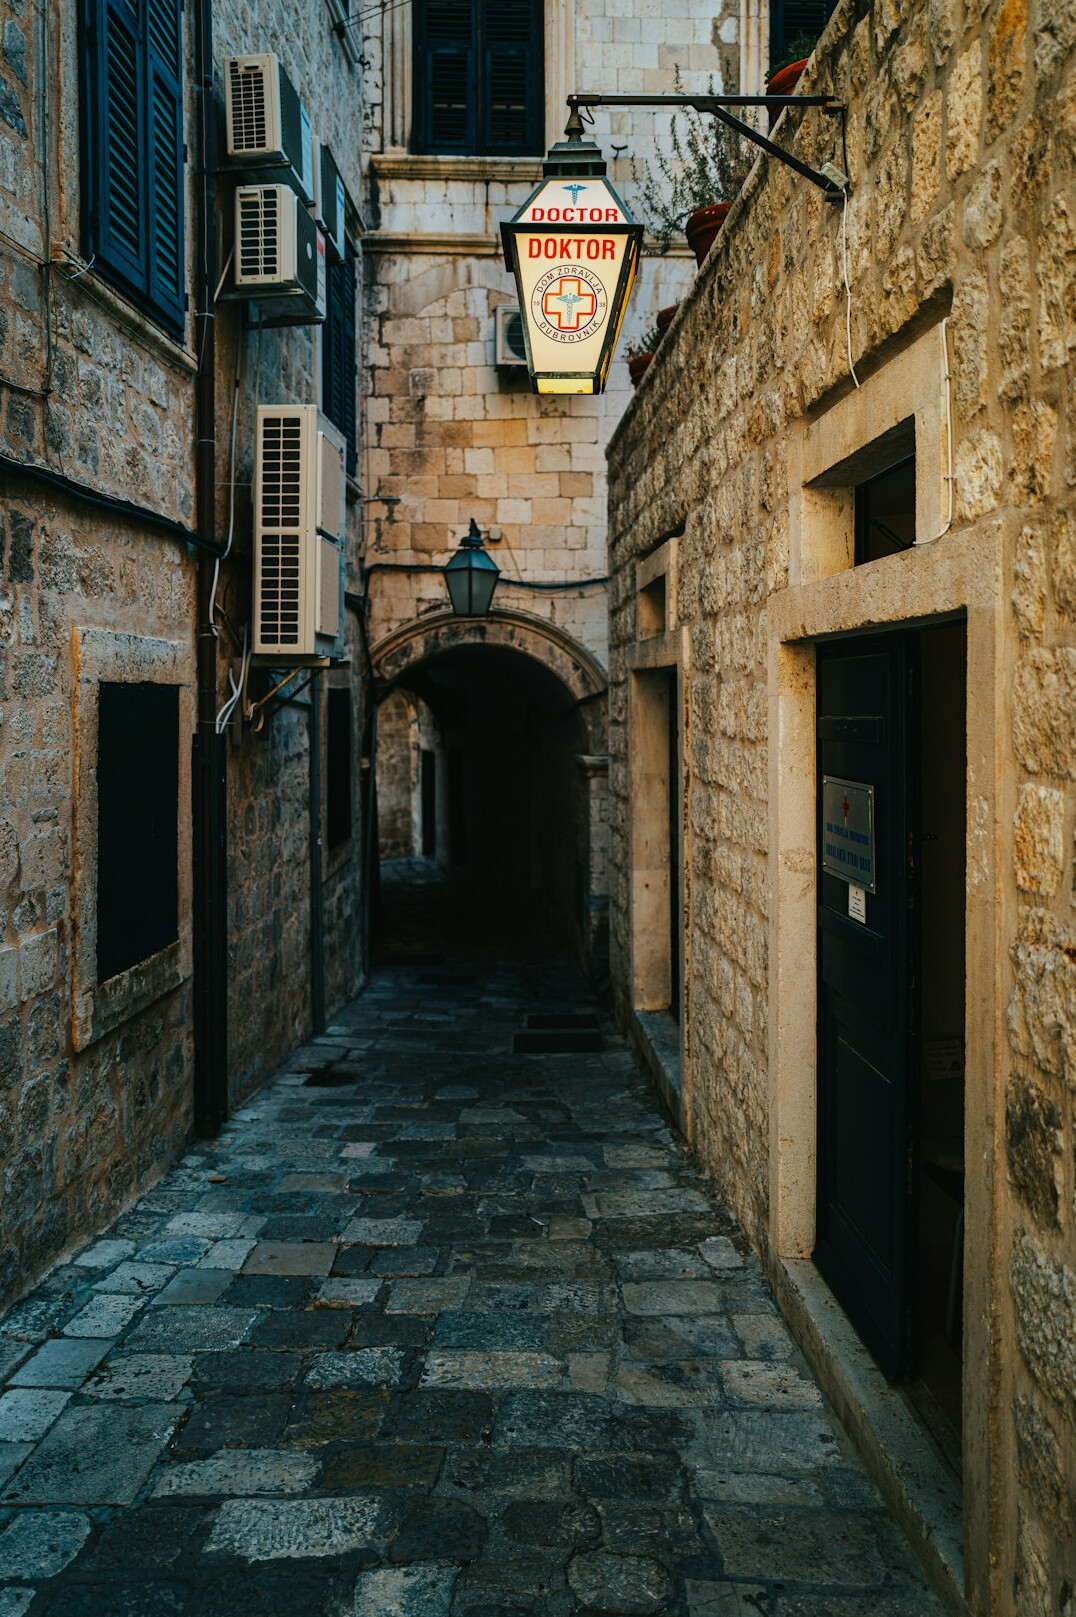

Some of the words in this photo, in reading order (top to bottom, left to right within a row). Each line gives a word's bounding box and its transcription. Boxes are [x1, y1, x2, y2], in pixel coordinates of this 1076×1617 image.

[532, 207, 619, 222] DOCTOR
[528, 238, 616, 260] DOKTOR
[536, 273, 555, 293] DOM
[557, 267, 603, 294] ZDRAVLJA
[539, 320, 600, 341] DUBROVNIK
